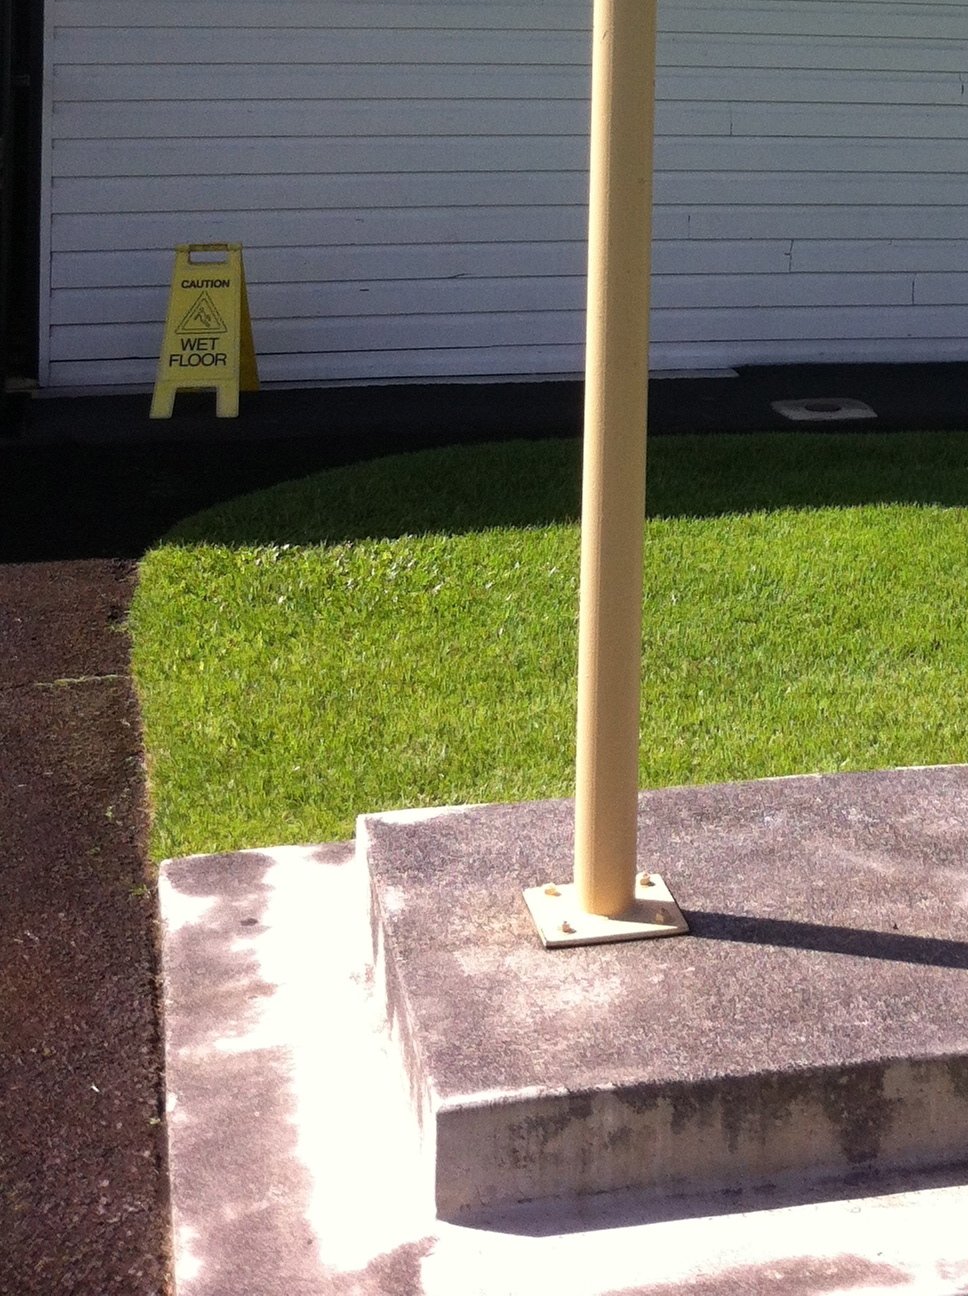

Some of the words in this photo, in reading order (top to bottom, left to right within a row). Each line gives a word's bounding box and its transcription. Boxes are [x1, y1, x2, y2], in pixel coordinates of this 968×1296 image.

[181, 279, 231, 289] CAUTION
[180, 338, 219, 351] WET
[168, 353, 227, 367] FLOOR
